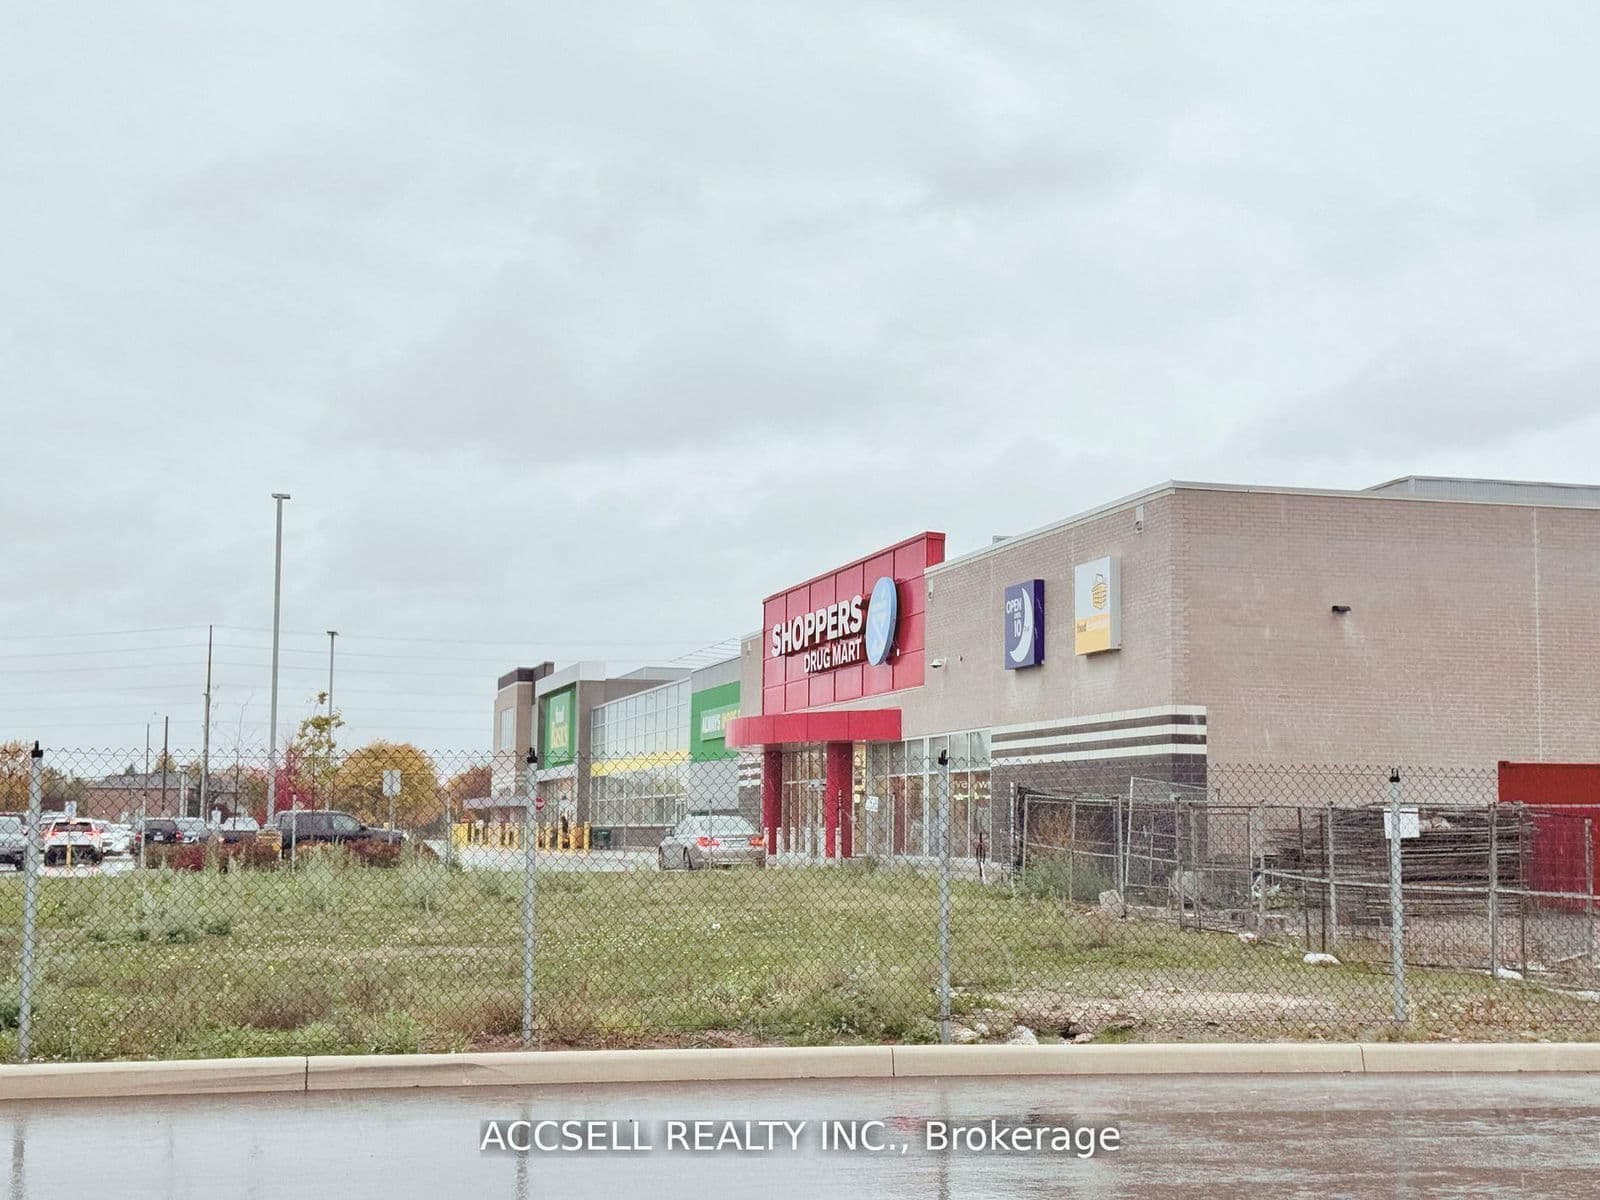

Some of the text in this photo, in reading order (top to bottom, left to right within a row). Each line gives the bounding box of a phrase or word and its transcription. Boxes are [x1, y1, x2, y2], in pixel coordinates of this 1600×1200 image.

[771, 595, 863, 657] SHOPPERS
[1013, 619, 1022, 638] 10
[803, 636, 862, 673] DRUG MART
